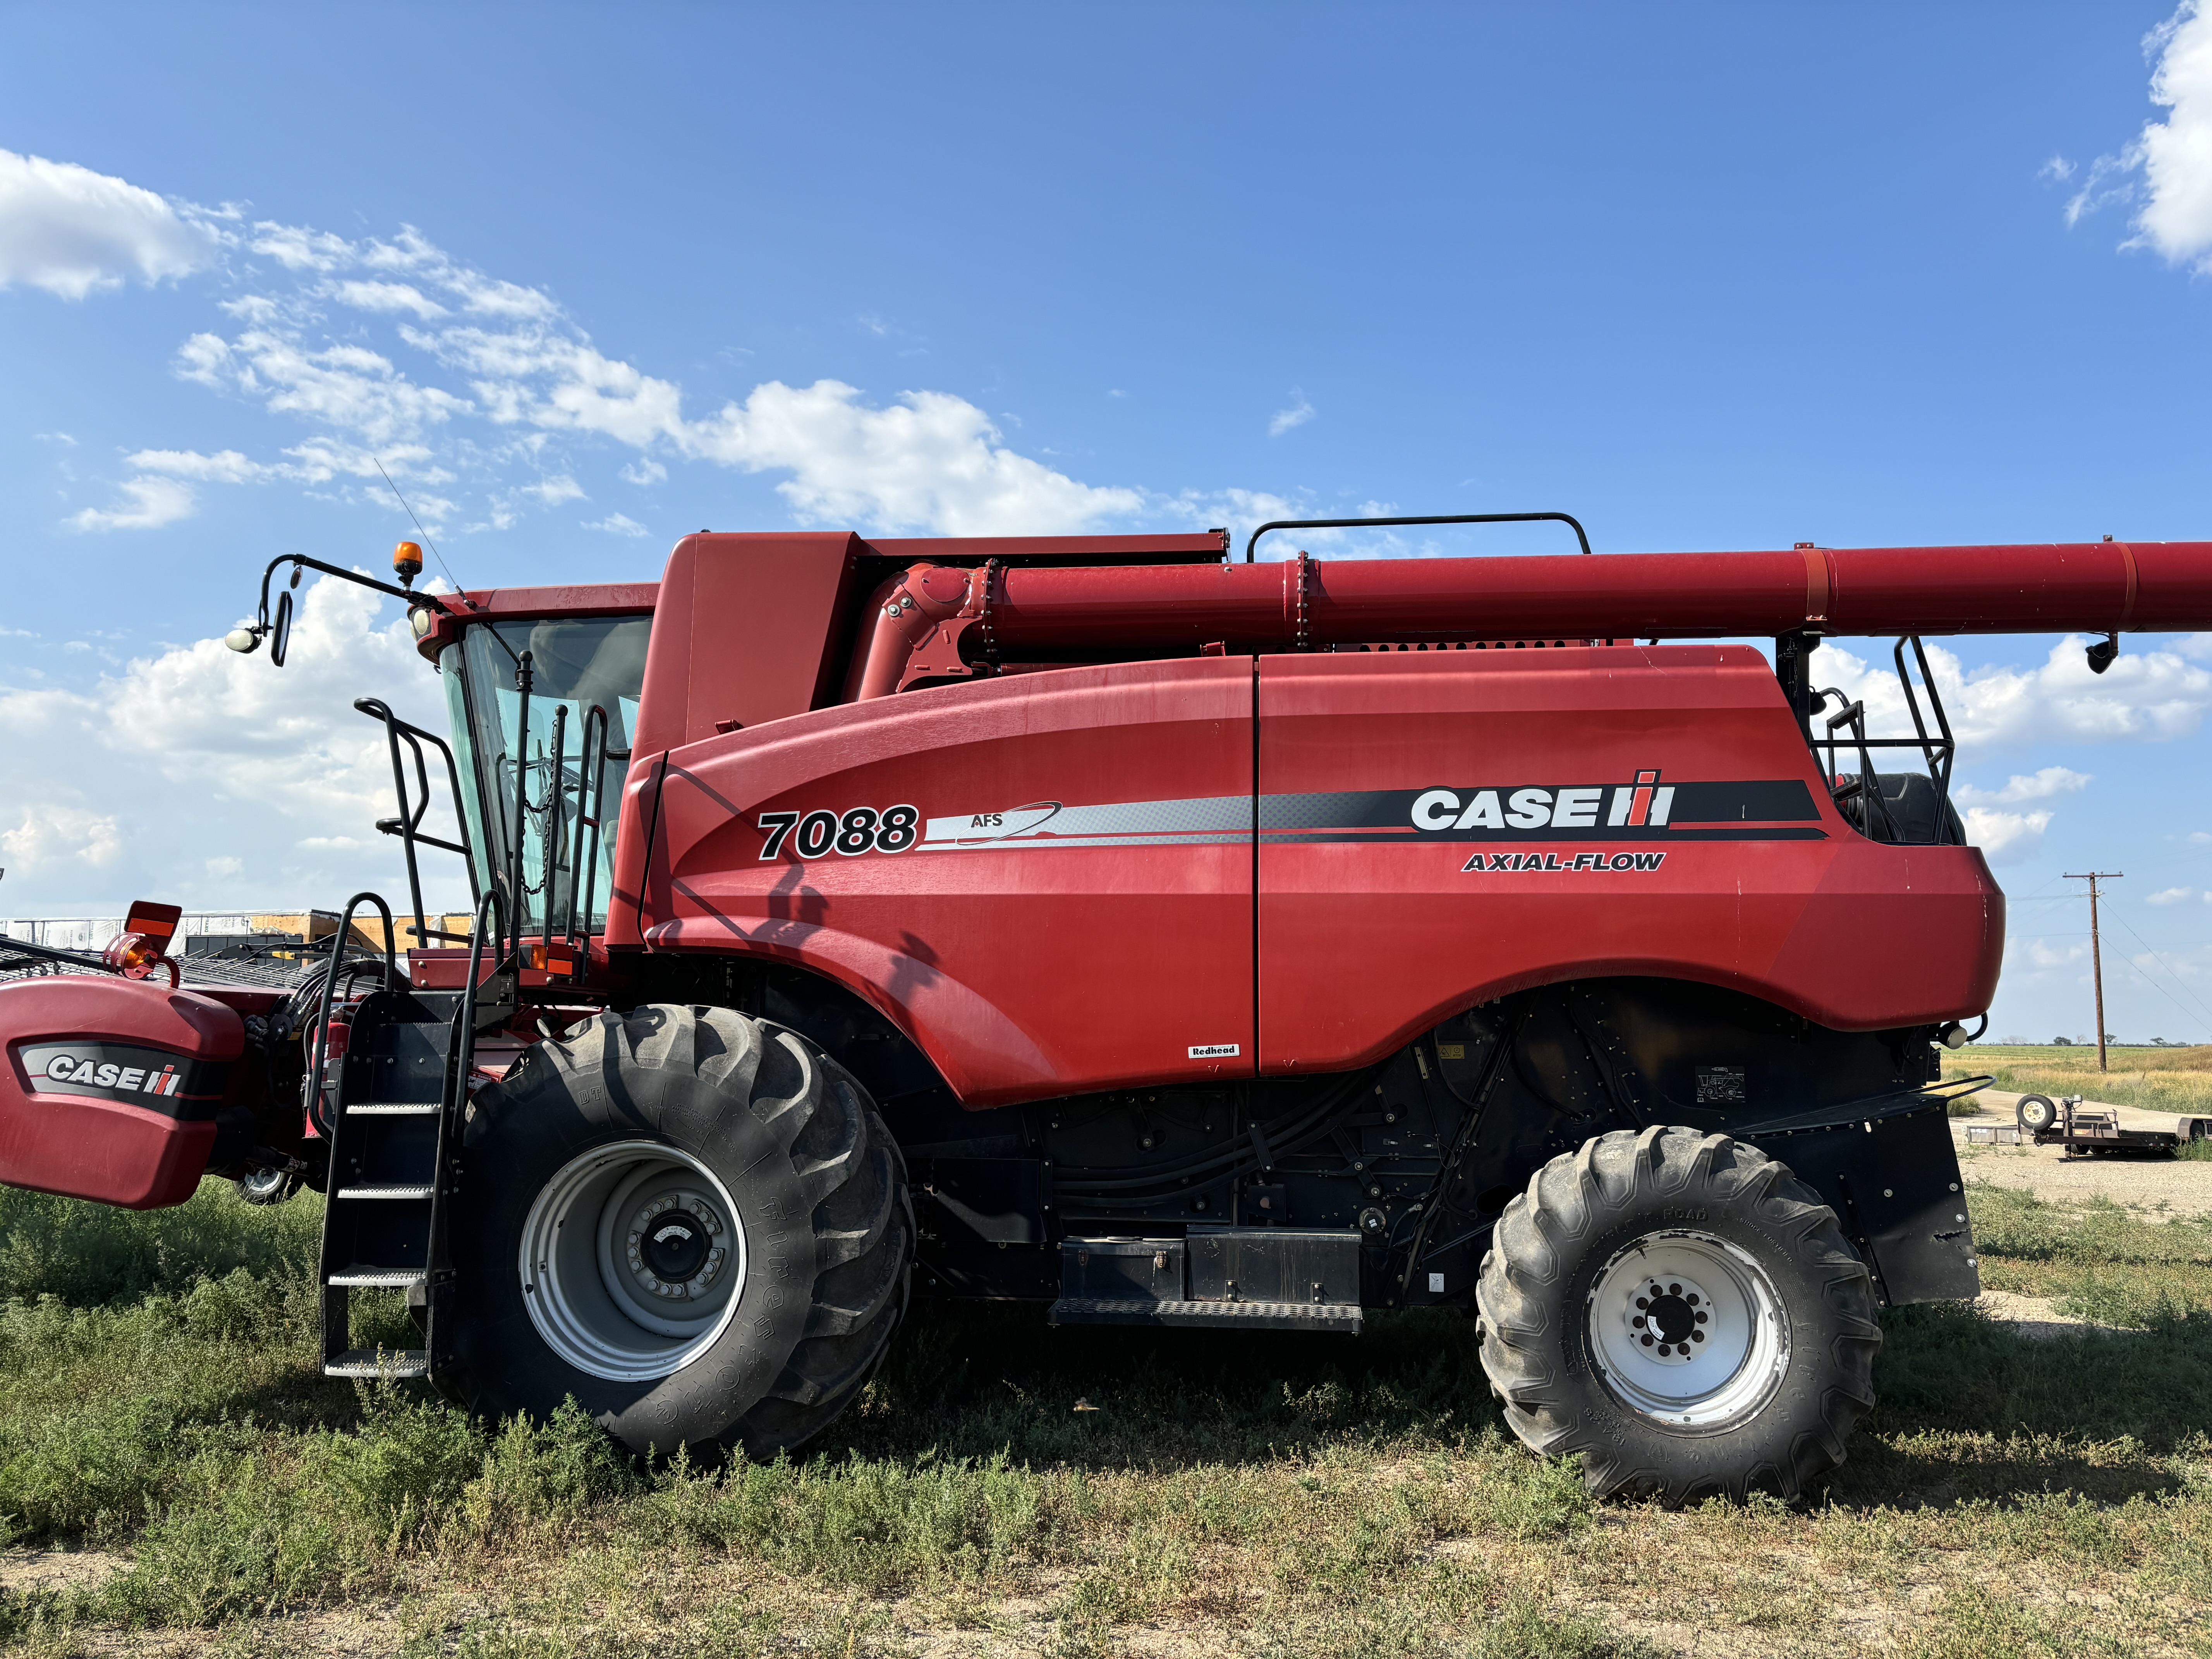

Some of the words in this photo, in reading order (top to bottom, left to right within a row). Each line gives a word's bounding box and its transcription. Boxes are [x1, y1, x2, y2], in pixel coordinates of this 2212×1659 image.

[1411, 788, 1602, 831] CASE
[970, 813, 1003, 828] AFS
[758, 804, 919, 860] 7088
[1461, 852, 1667, 872] AXIAL-FLOW
[1193, 1045, 1235, 1055] Redhead
[48, 1056, 146, 1091] CASE
[579, 1086, 601, 1105] DT
